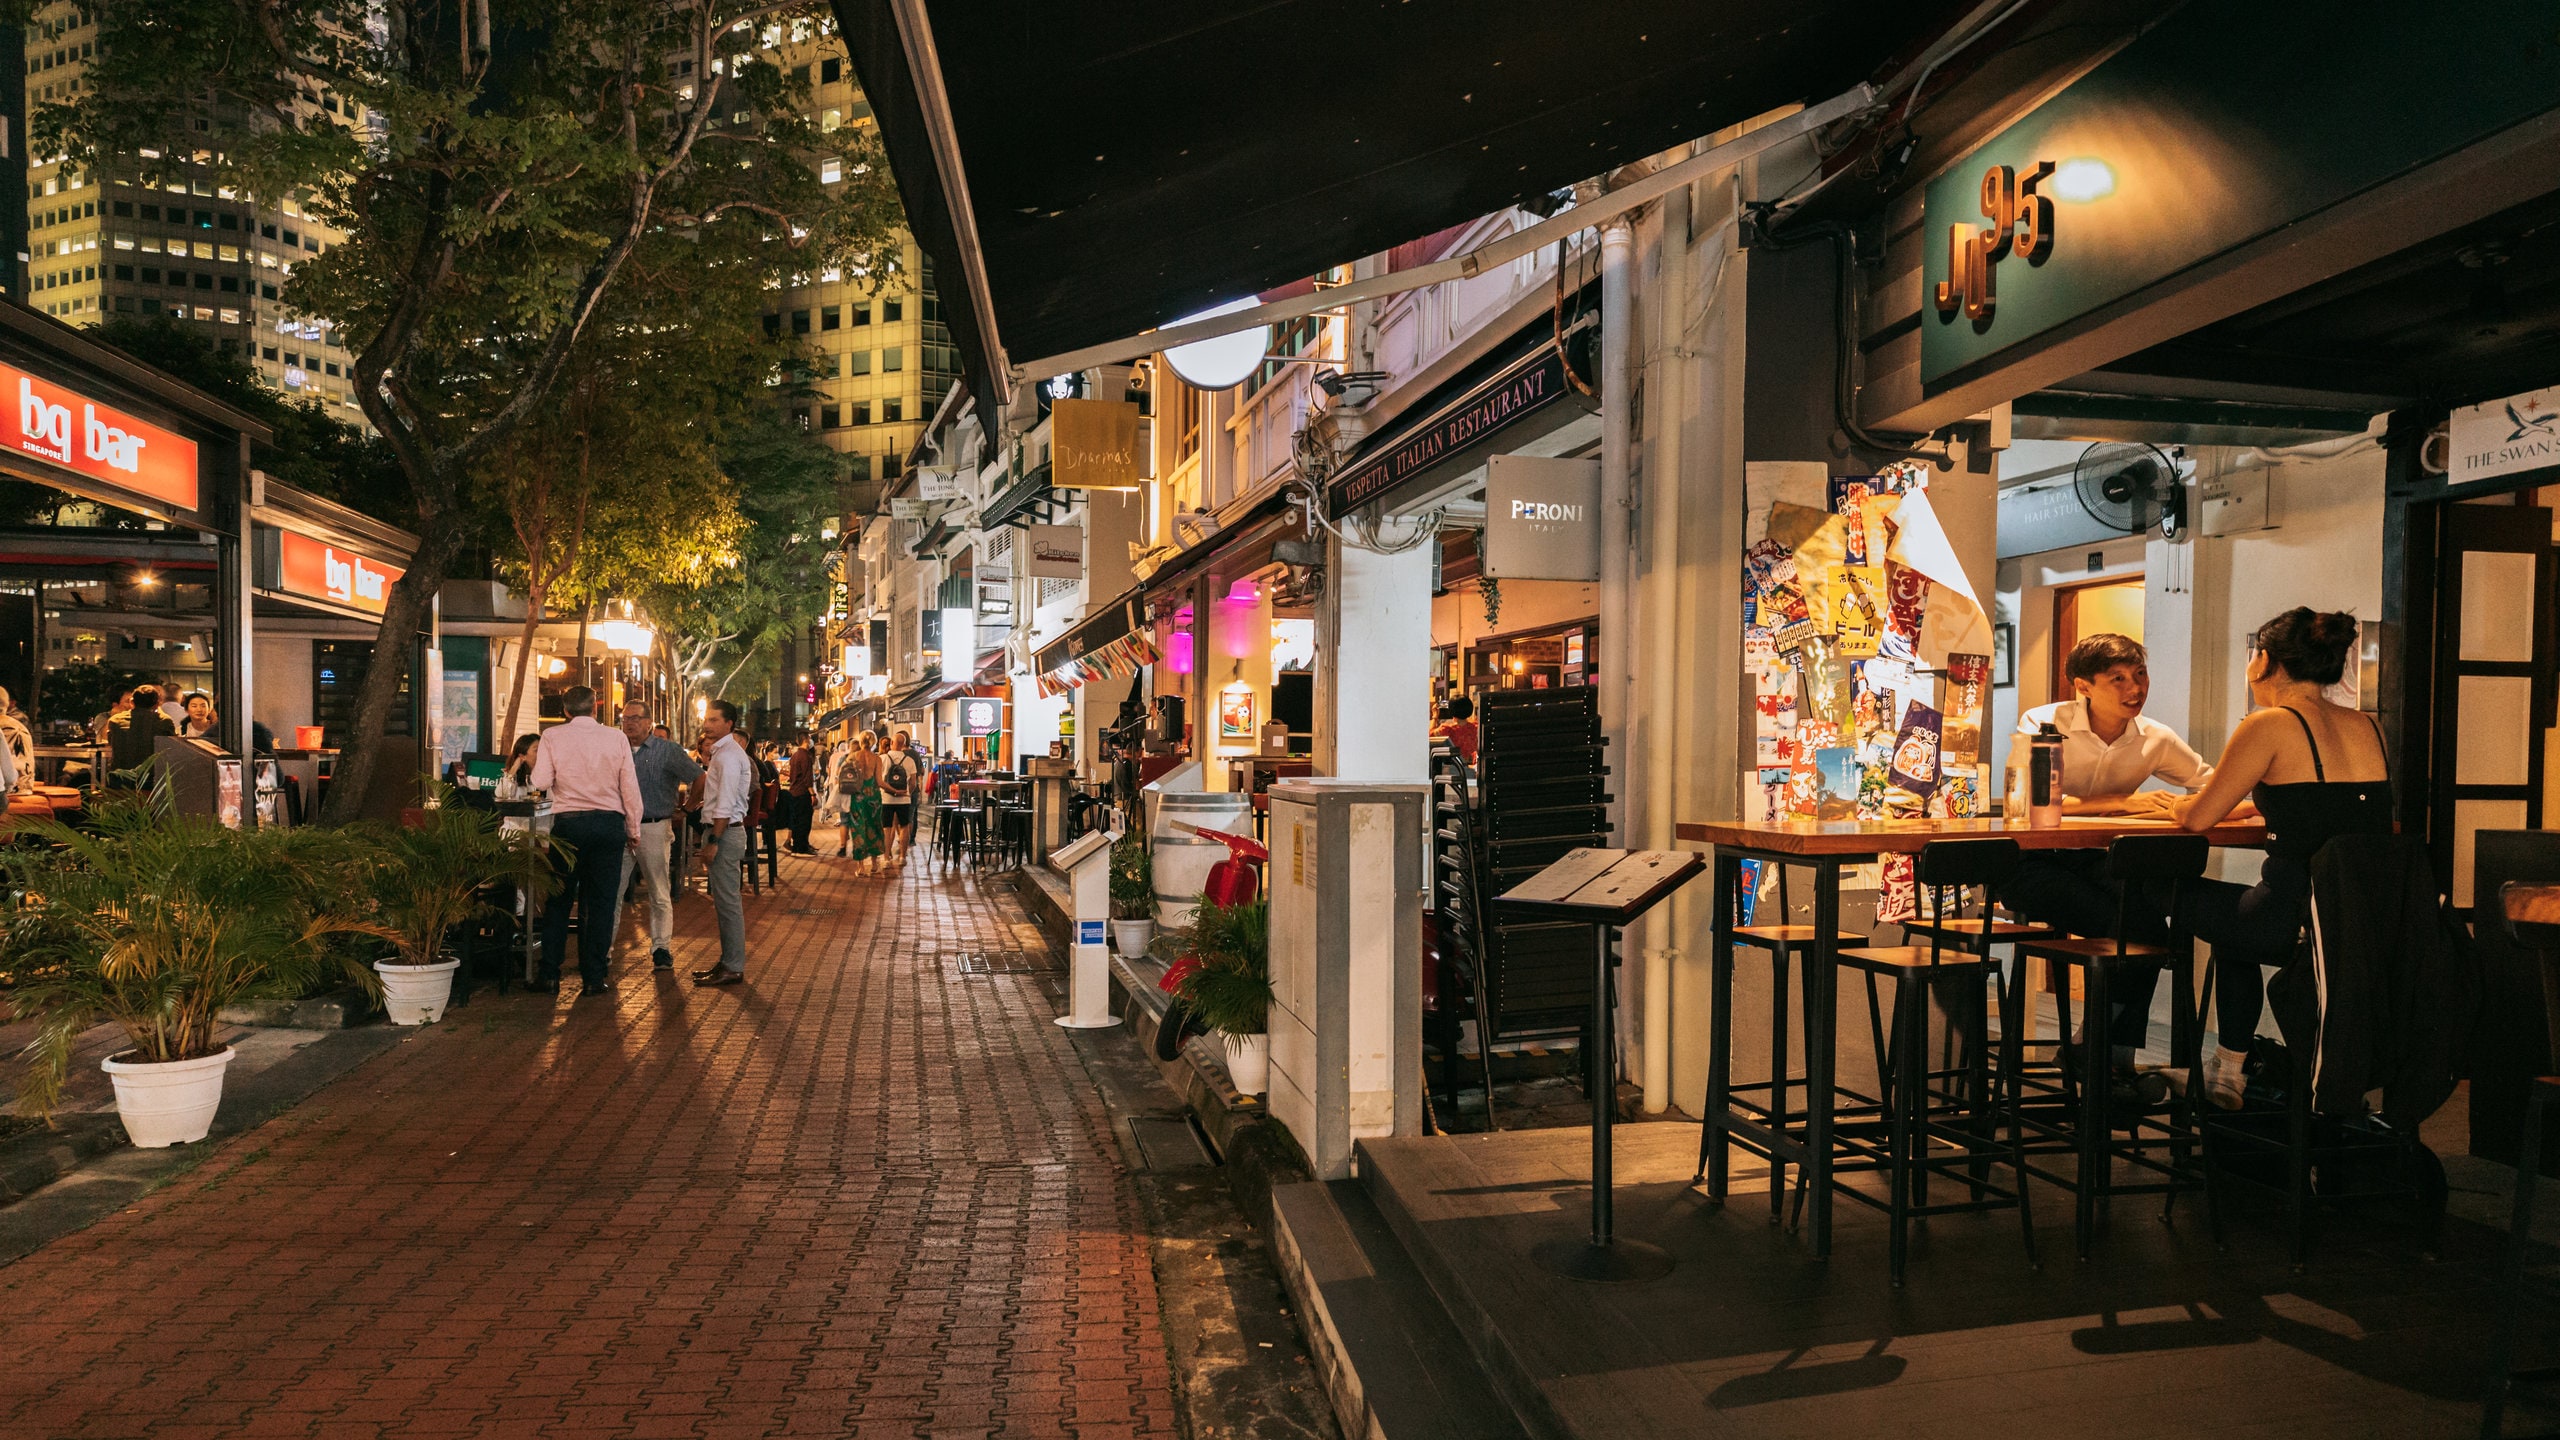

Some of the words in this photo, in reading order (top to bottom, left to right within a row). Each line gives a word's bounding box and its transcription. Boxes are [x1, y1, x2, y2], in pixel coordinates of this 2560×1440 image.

[20, 376, 72, 463] bq
[84, 403, 146, 473] bar
[1346, 464, 1390, 503] VESPETTA
[1396, 429, 1444, 477] ITALIAN
[1449, 368, 1546, 446] RESTAURANT
[22, 440, 63, 462] SINGAPORE
[2464, 451, 2496, 469] THE
[2499, 440, 2550, 463] SWAN
[923, 485, 937, 493] THE
[1511, 499, 1583, 521] PERONI
[2024, 508, 2051, 524] HAIR
[325, 548, 351, 601] bq
[355, 557, 385, 601] bar
[1835, 621, 1876, 638] ビール
